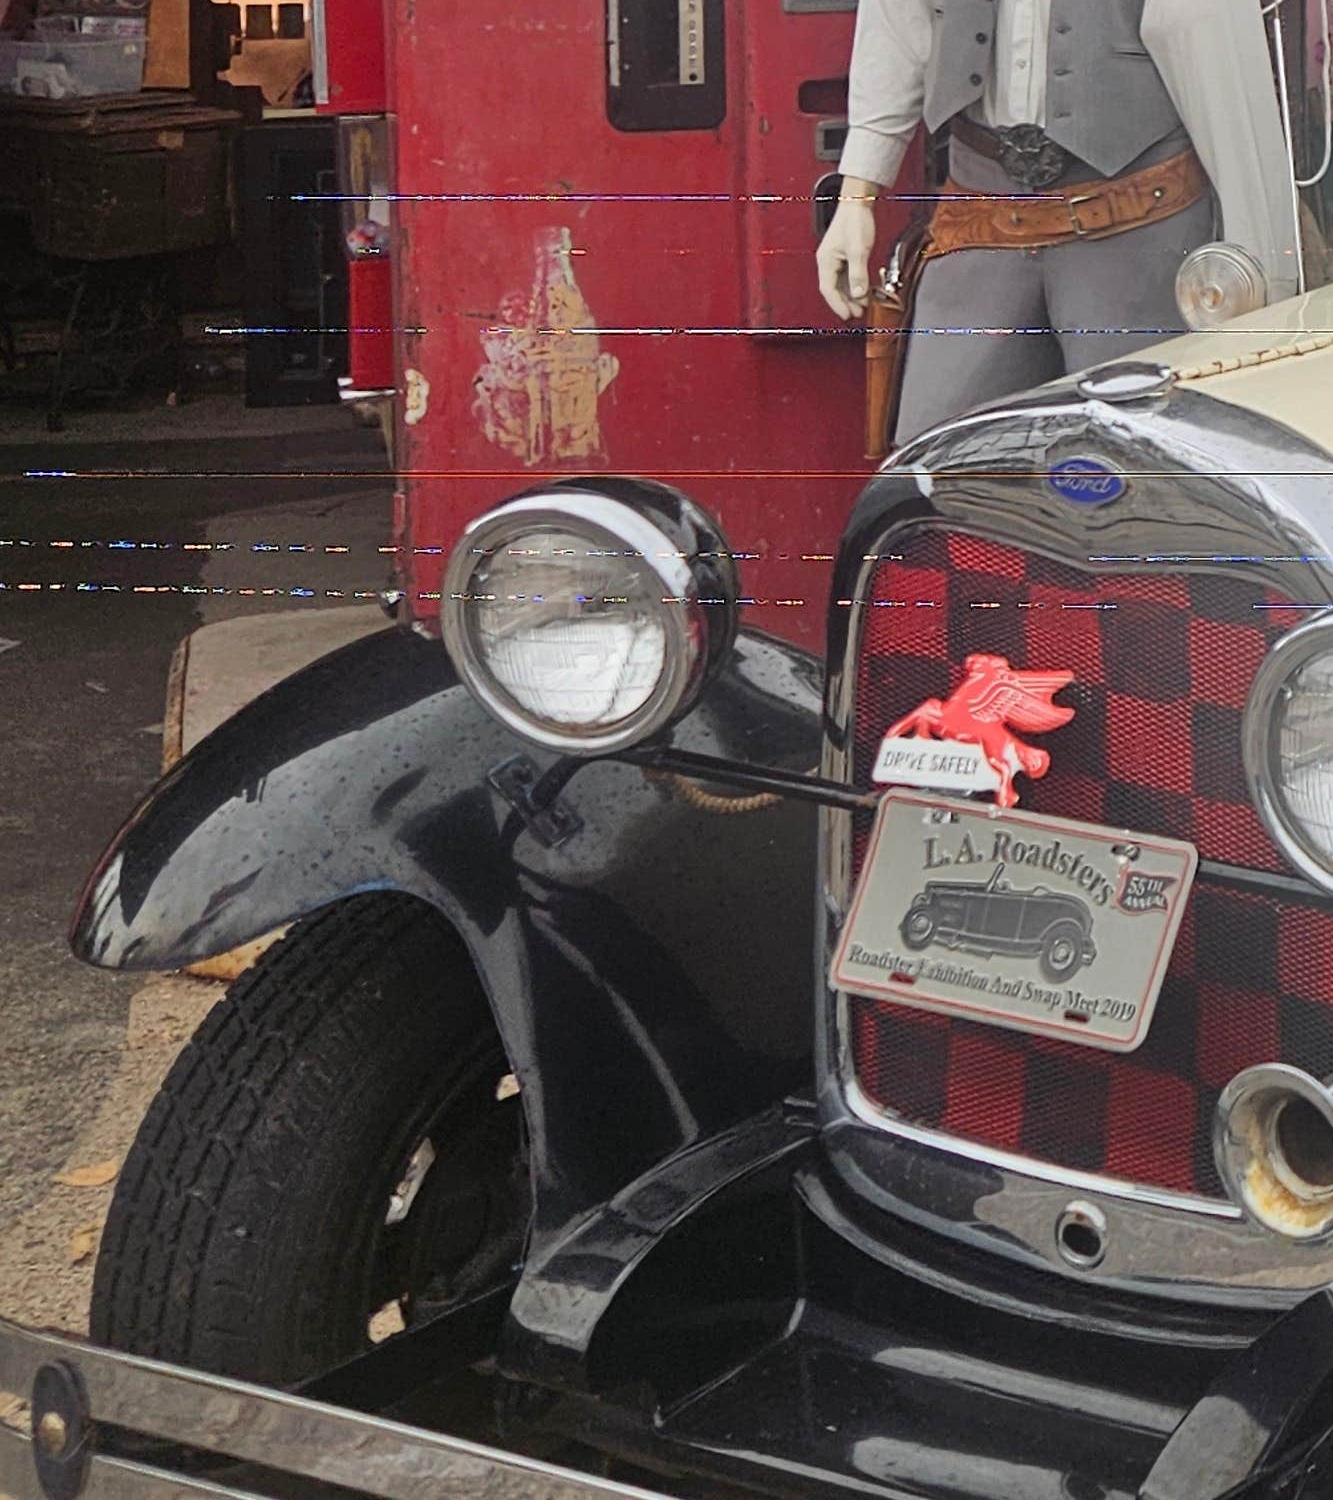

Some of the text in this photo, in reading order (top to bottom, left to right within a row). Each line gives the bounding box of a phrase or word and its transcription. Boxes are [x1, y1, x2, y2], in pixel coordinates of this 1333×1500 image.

[1055, 462, 1112, 493] Ford
[883, 750, 981, 775] DRIVE SAFELY
[922, 828, 1118, 911] L.A. Roadsters
[847, 942, 1137, 1023] Roadster Exhibition And Swap Meet 2019
